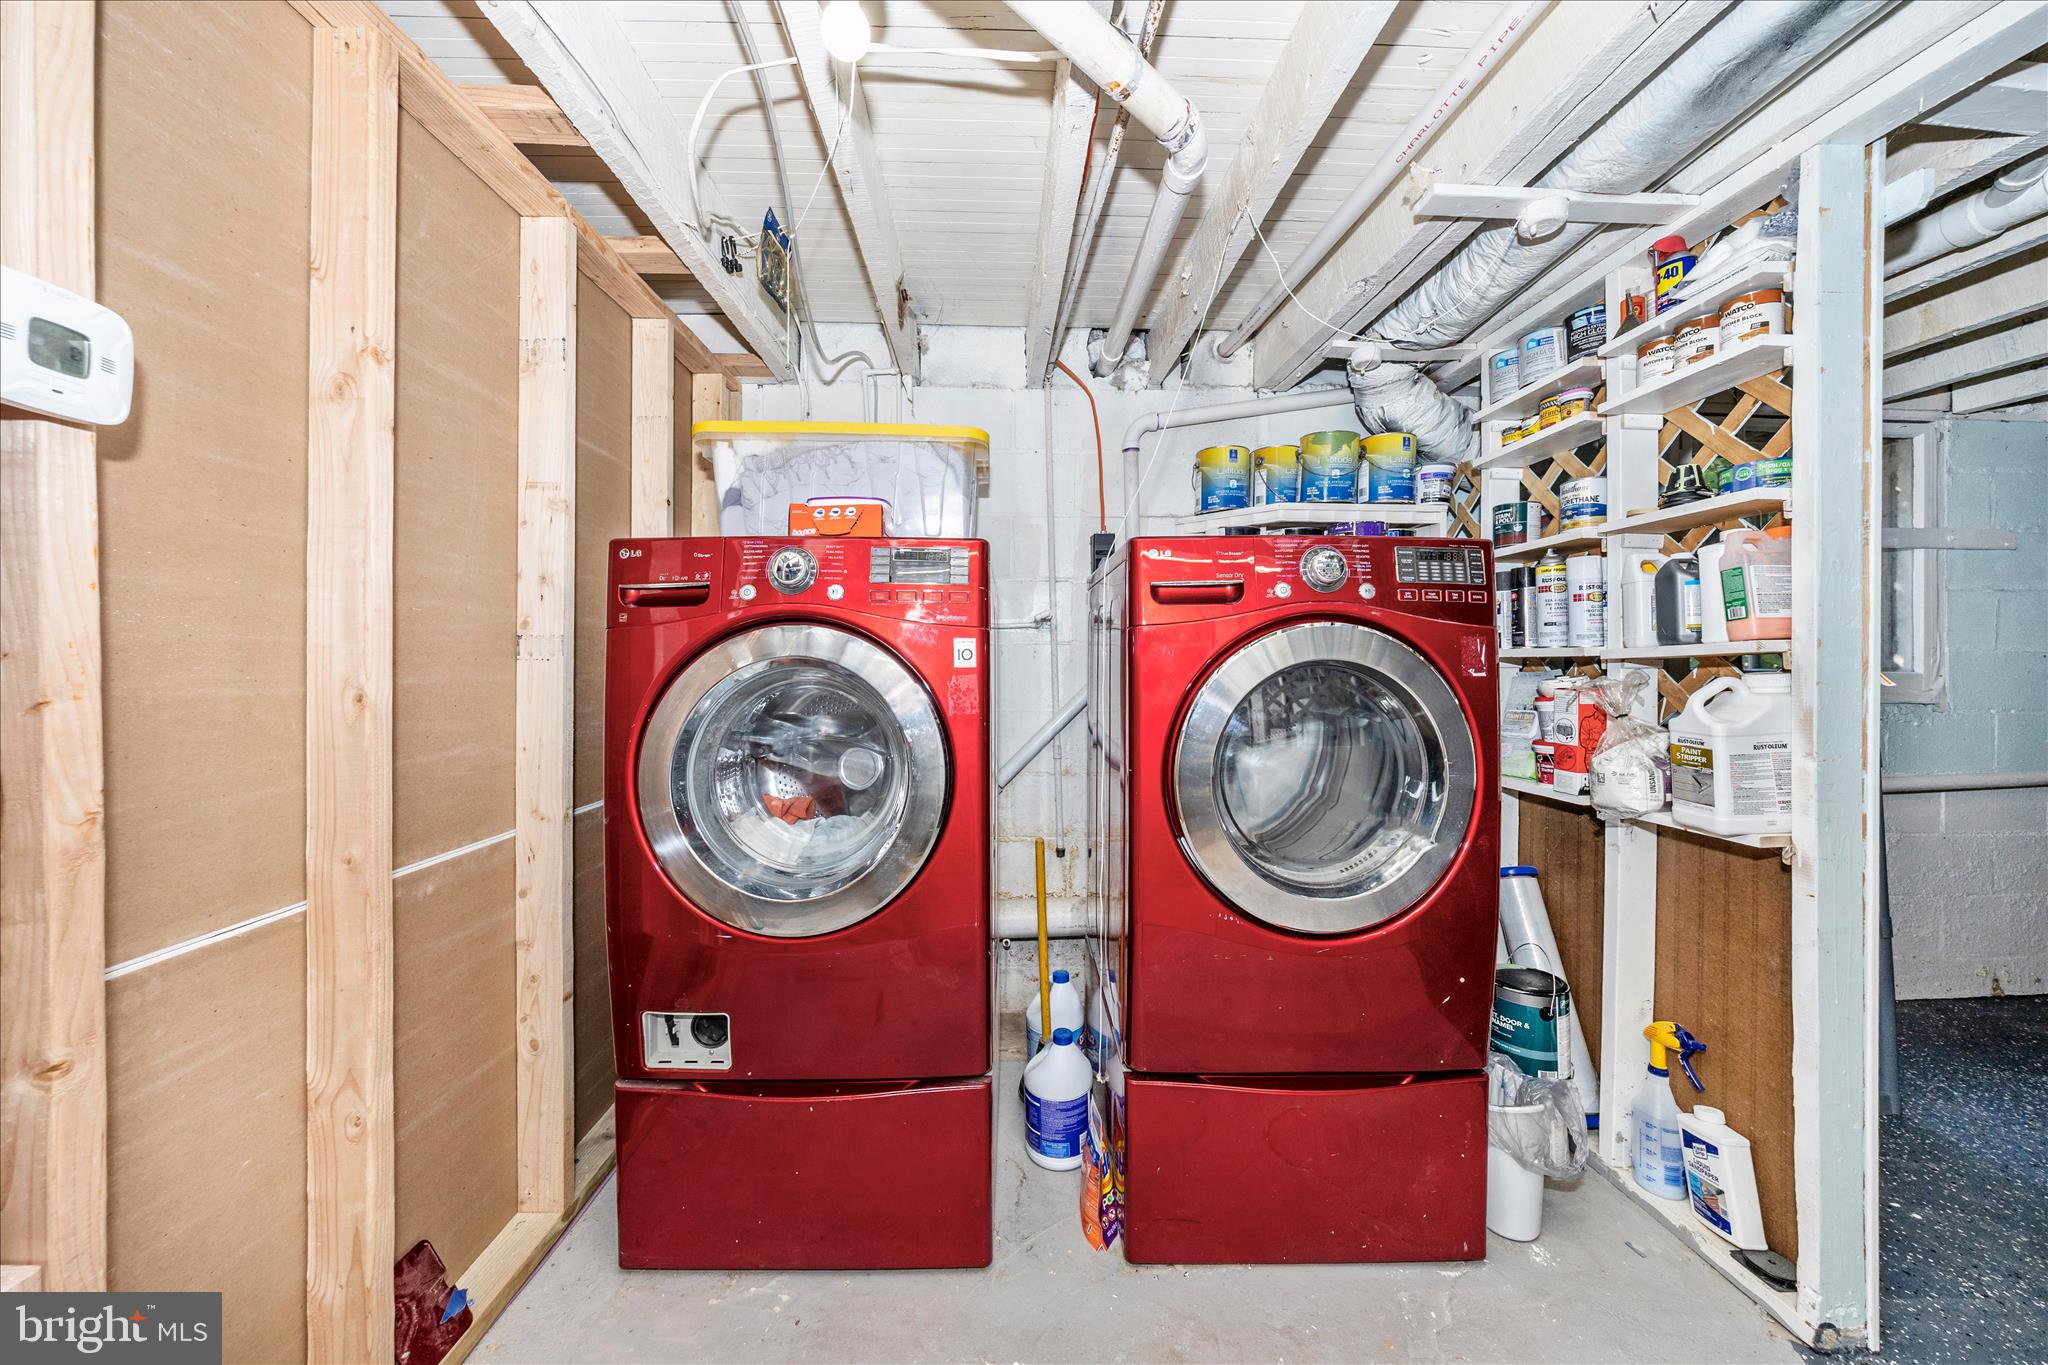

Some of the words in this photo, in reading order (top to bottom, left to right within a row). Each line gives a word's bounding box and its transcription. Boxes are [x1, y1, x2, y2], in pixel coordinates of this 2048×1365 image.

[1395, 78, 1470, 164] CHARLOTTE
[1477, 16, 1522, 67] PIPE
[1724, 303, 1755, 318] WATCO
[1741, 312, 1763, 321] BLOCK
[1675, 327, 1701, 342] WATCO
[1689, 336, 1709, 345] BLOCK
[1676, 752, 1707, 764] STRIPPER
[1681, 746, 1702, 756] PAINT
[1500, 1015, 1523, 1028] DOOR
[1523, 1022, 1531, 1030] &
[1687, 1161, 1720, 1183] SANDPAPER
[1693, 1157, 1711, 1172] LIQUID
